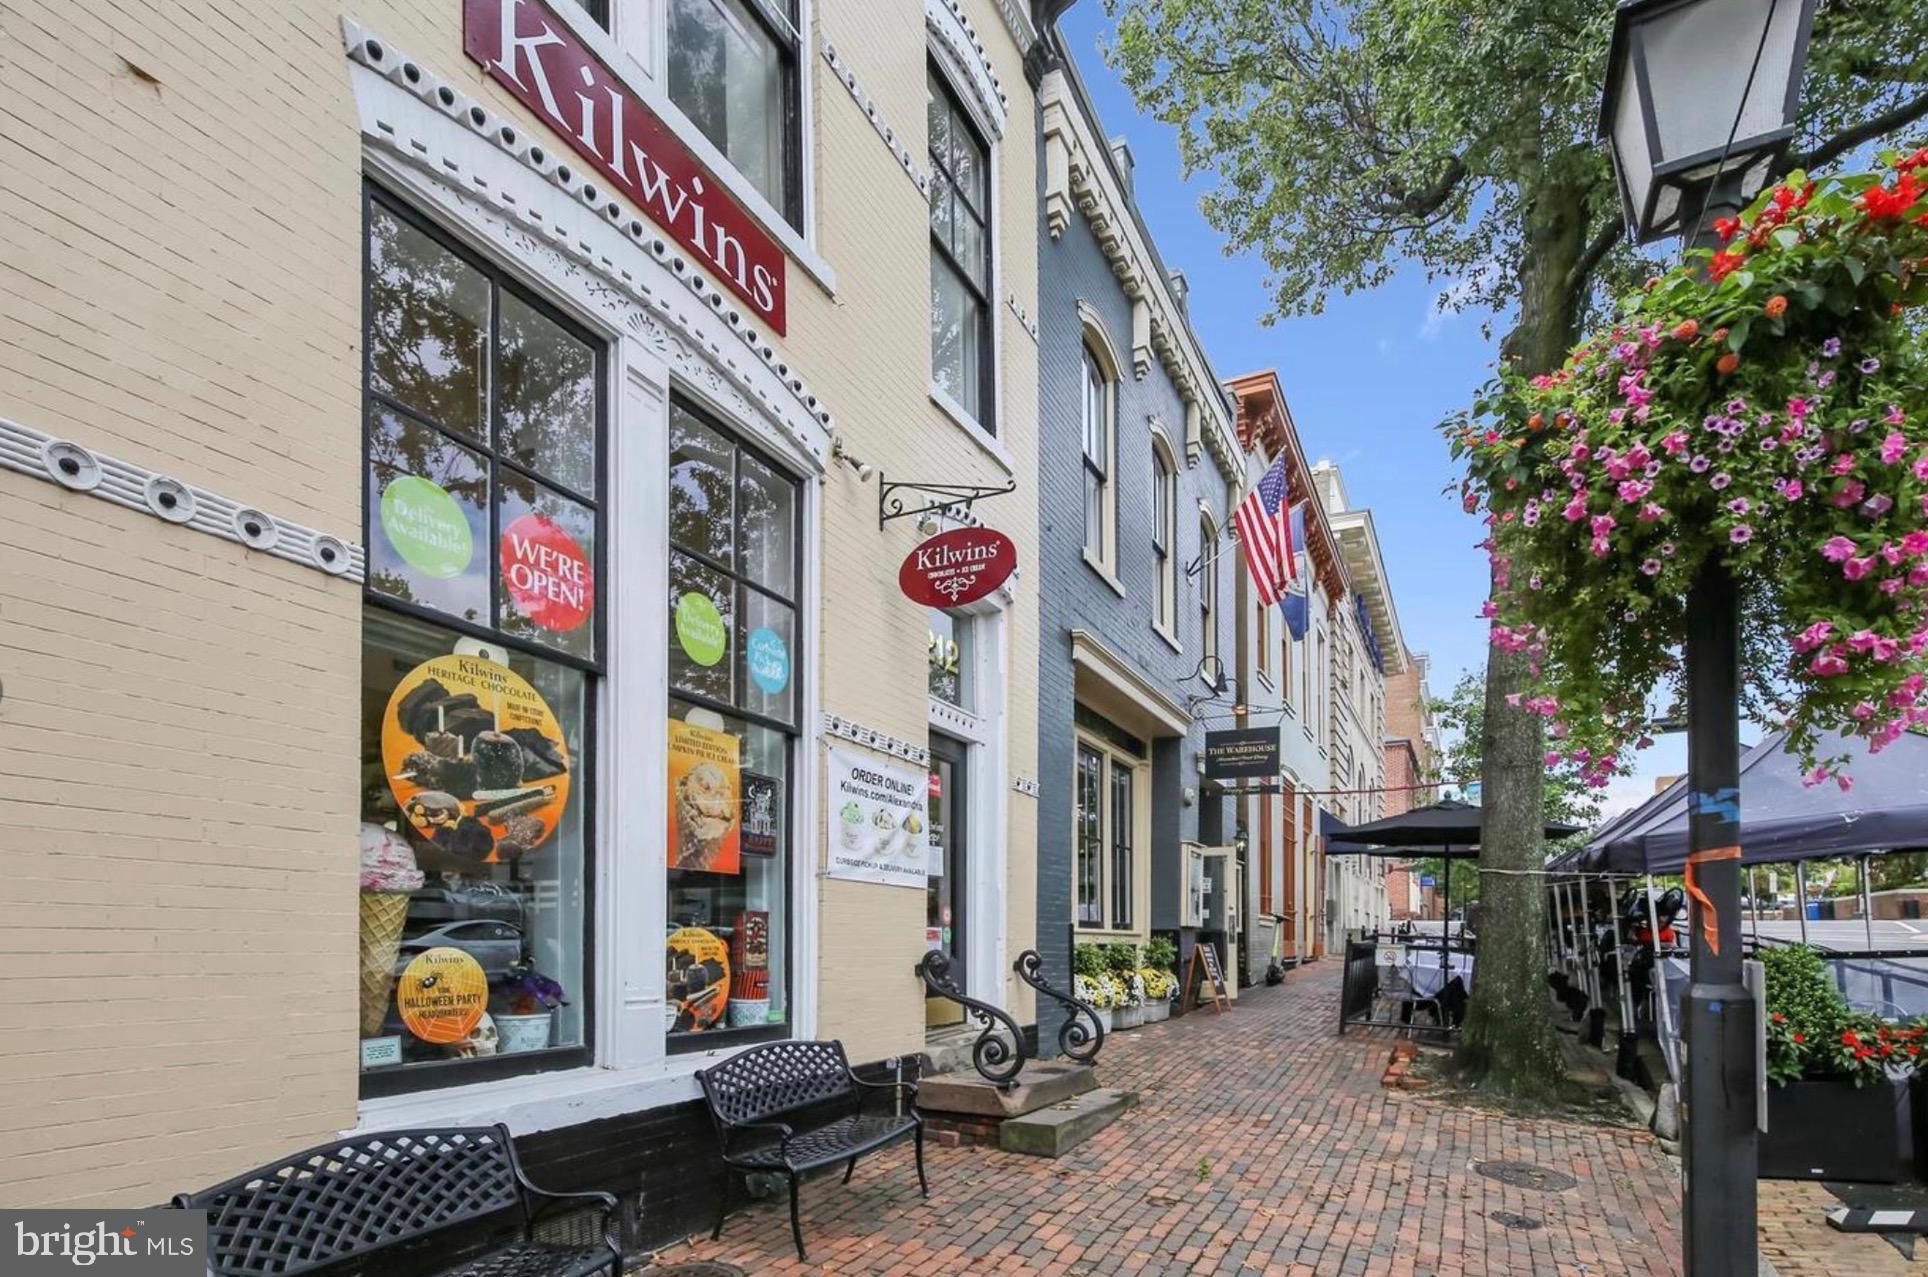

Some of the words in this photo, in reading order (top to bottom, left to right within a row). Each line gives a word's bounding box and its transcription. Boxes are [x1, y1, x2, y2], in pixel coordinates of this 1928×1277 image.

[492, 0, 777, 313] Kilwins
[512, 534, 584, 585] WE'RE
[916, 542, 998, 570] Kilwins
[510, 563, 584, 611] OPEN!
[428, 666, 476, 687] HERITAGE
[481, 680, 537, 702] CHOCOLATE
[459, 659, 508, 683] Kilwins
[1226, 744, 1276, 754] WAREHOUSE
[851, 768, 883, 787] ORDER
[885, 778, 914, 796] ONLINE!
[425, 955, 464, 964] Kilwins
[404, 995, 454, 1008] HALLOWEEN
[456, 994, 481, 1005] PARTY
